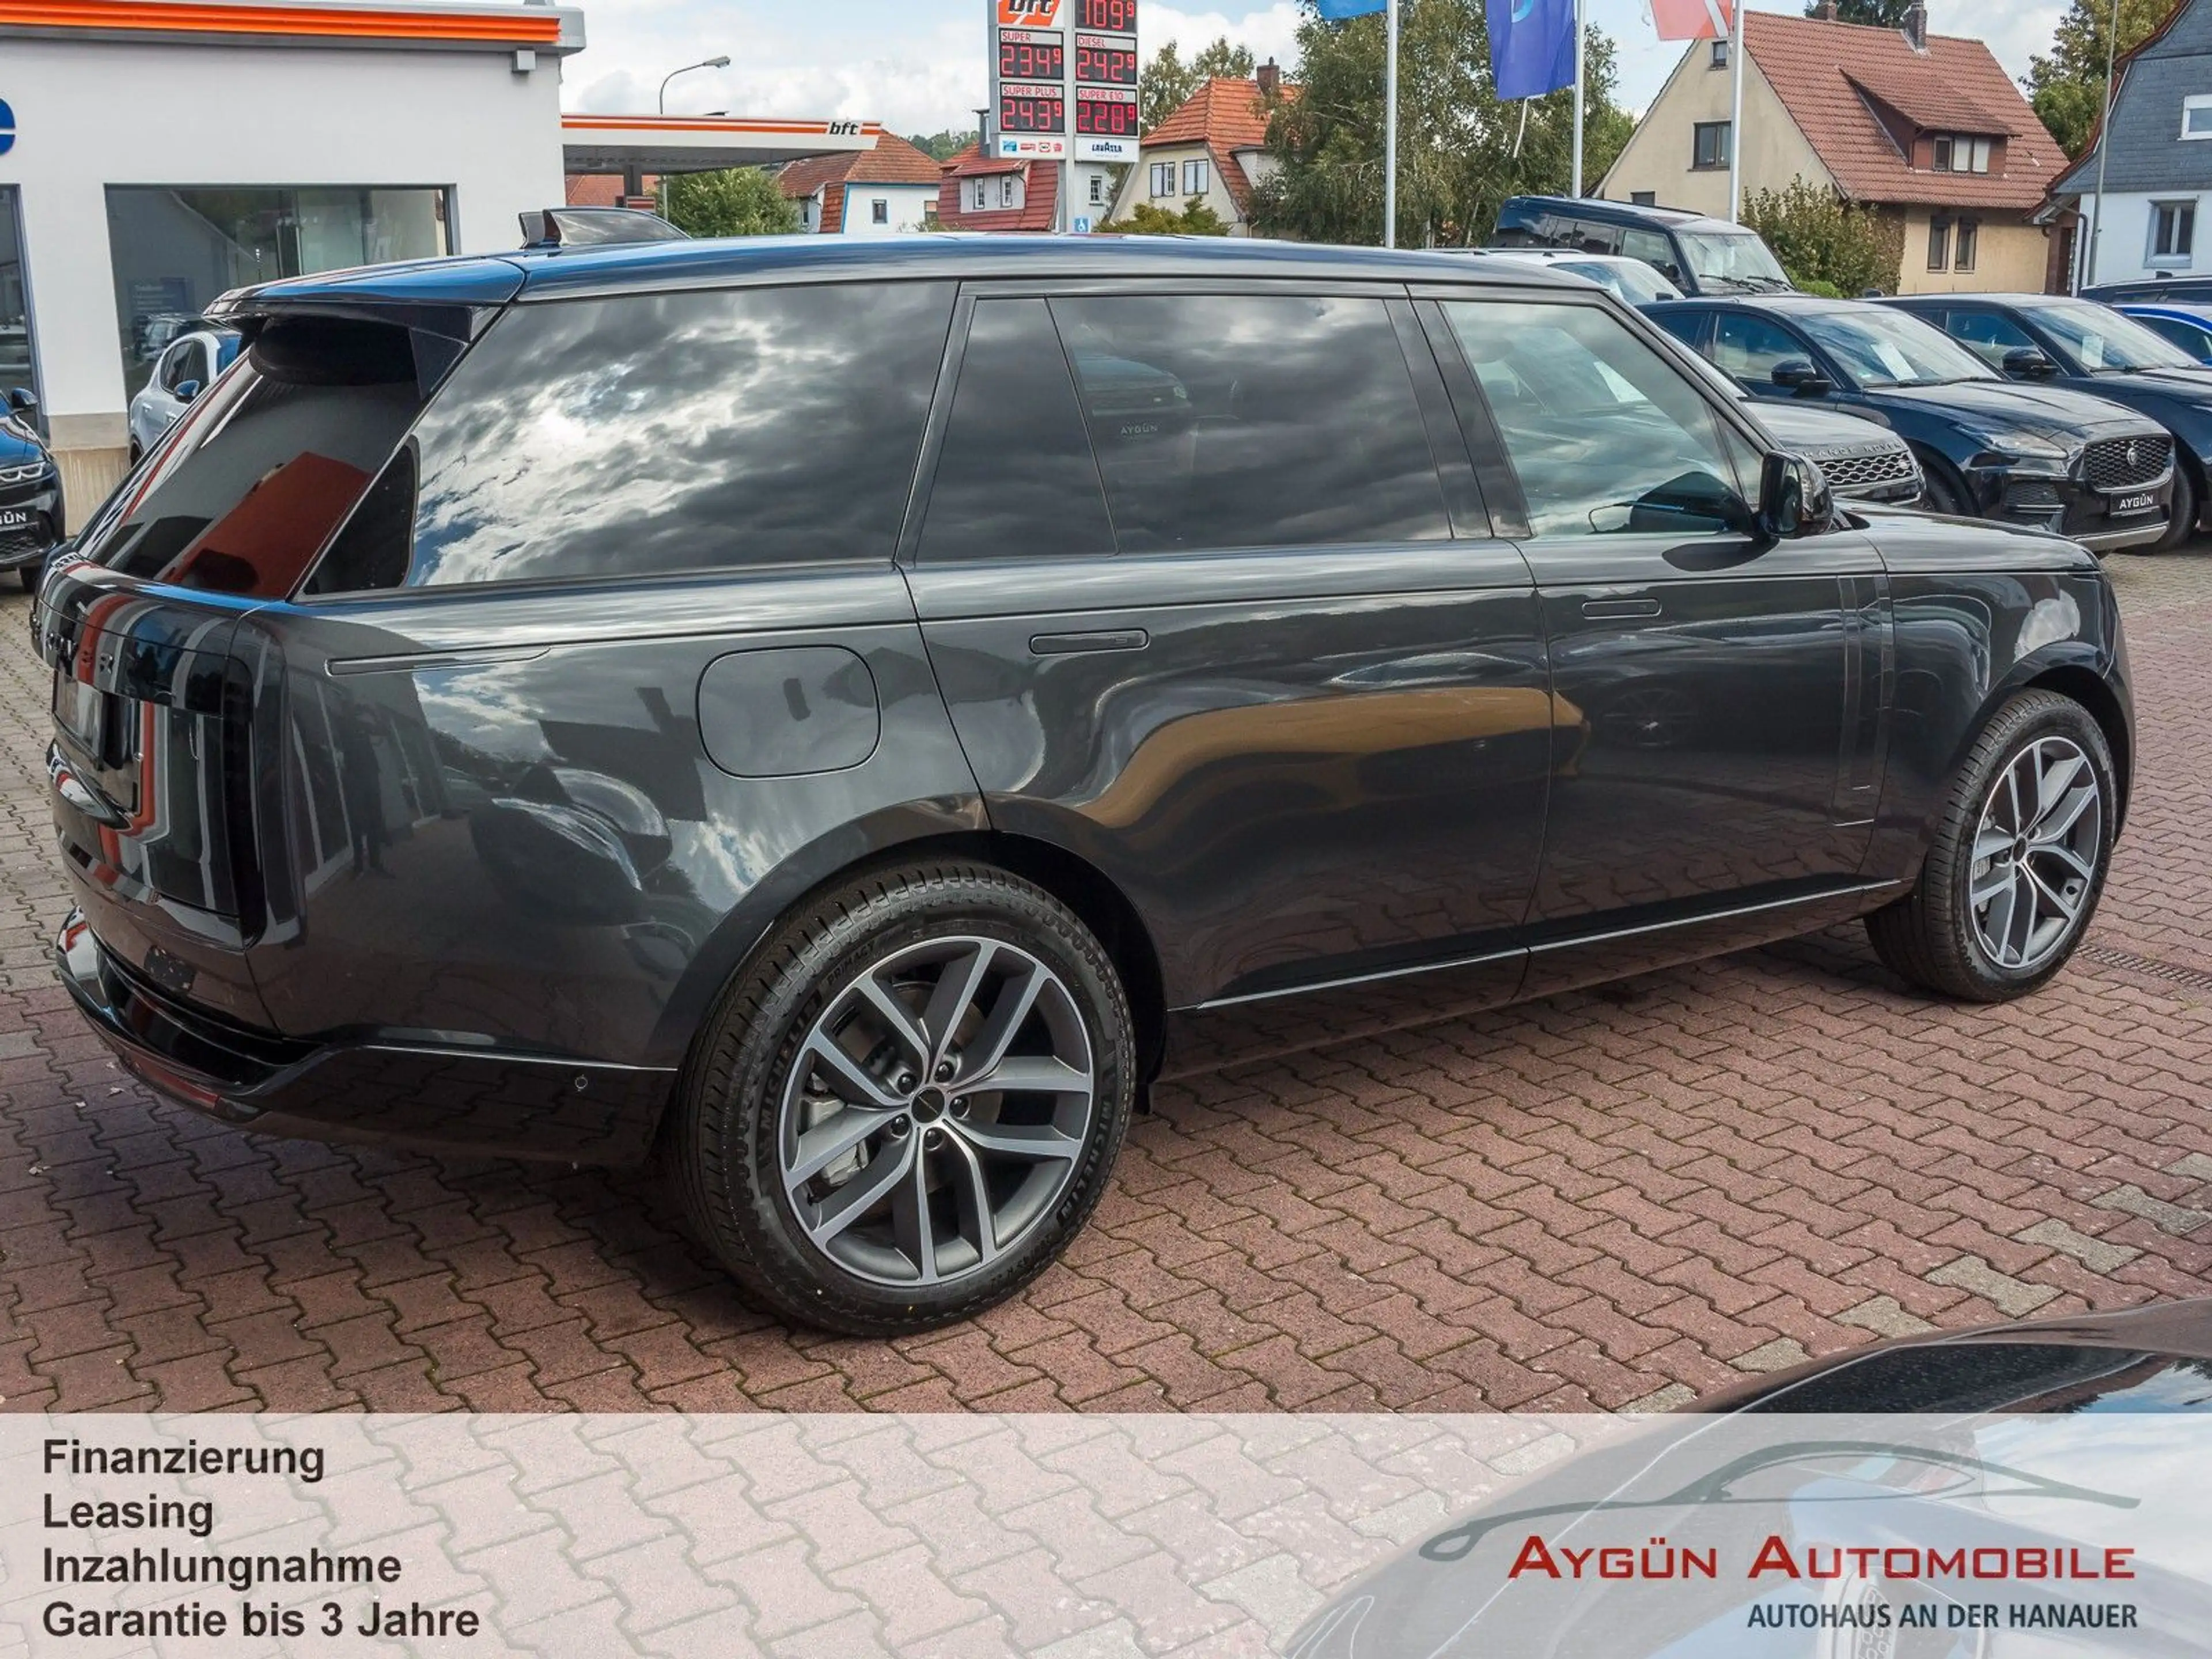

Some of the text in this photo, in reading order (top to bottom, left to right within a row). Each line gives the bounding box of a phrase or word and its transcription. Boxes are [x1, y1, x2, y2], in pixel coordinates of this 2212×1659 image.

[1002, 32, 1031, 41] SUPER
[1078, 36, 1106, 48] DIESEL
[1003, 86, 1056, 96] SUPER PLUS
[1079, 90, 1123, 100] SUPER E10
[830, 122, 858, 135] bft
[2119, 493, 2153, 509] AYGÜN
[0, 511, 26, 525] ÜN
[1058, 1100, 1113, 1220] MICHELIN
